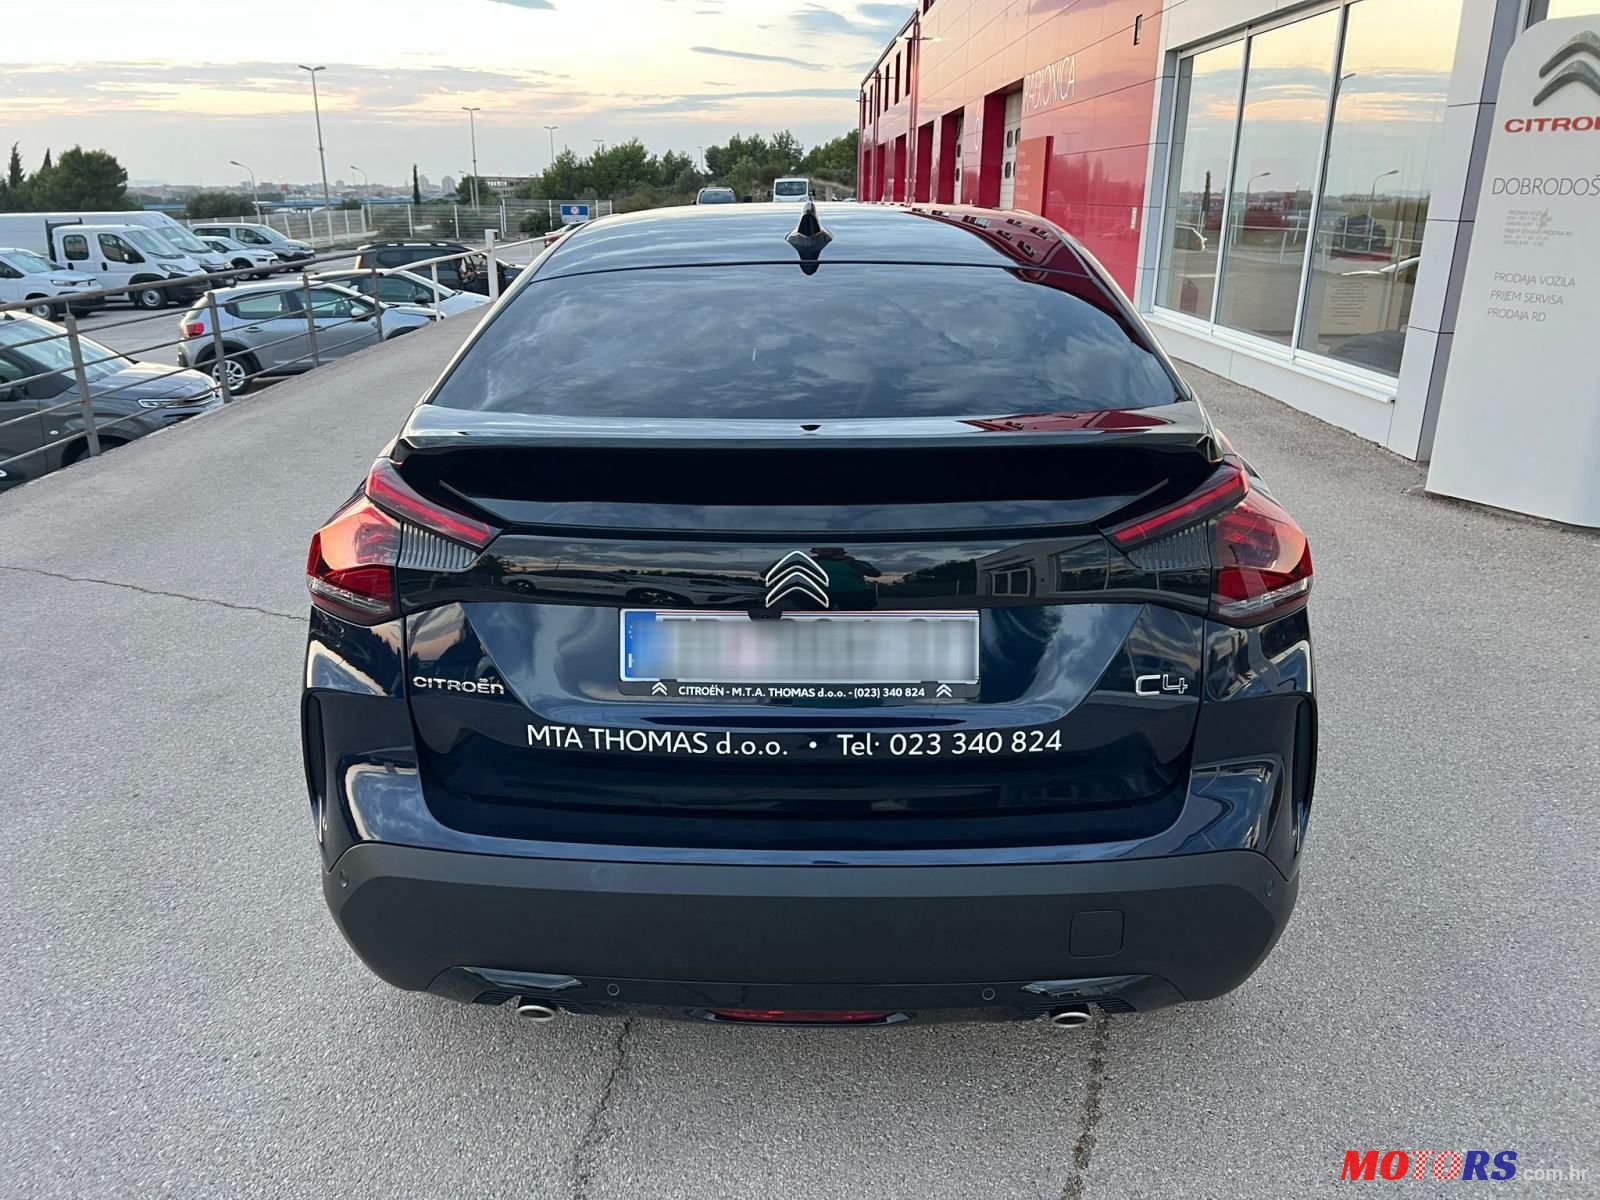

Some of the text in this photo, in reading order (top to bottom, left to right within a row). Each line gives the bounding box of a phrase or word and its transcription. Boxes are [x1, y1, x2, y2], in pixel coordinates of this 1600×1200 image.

[1494, 272, 1575, 288] PRODAJA VOZILA
[1490, 289, 1564, 305] PRIJEM SERVISA
[1487, 307, 1547, 322] PRODAJA RD
[678, 684, 724, 696] CITROËN
[731, 687, 766, 697] M.T.A.
[767, 687, 816, 698] THOMAS
[817, 687, 846, 698] d.o.o.
[854, 687, 880, 699] (023)
[882, 688, 903, 698] 340
[904, 688, 925, 698] 824
[1135, 674, 1188, 697] C4
[526, 724, 583, 749] MTA
[588, 728, 708, 754] THOMAS
[715, 732, 788, 756] d.o.o.
[889, 733, 941, 756] 023
[951, 732, 1002, 754] 340
[1010, 729, 1062, 752] 824
